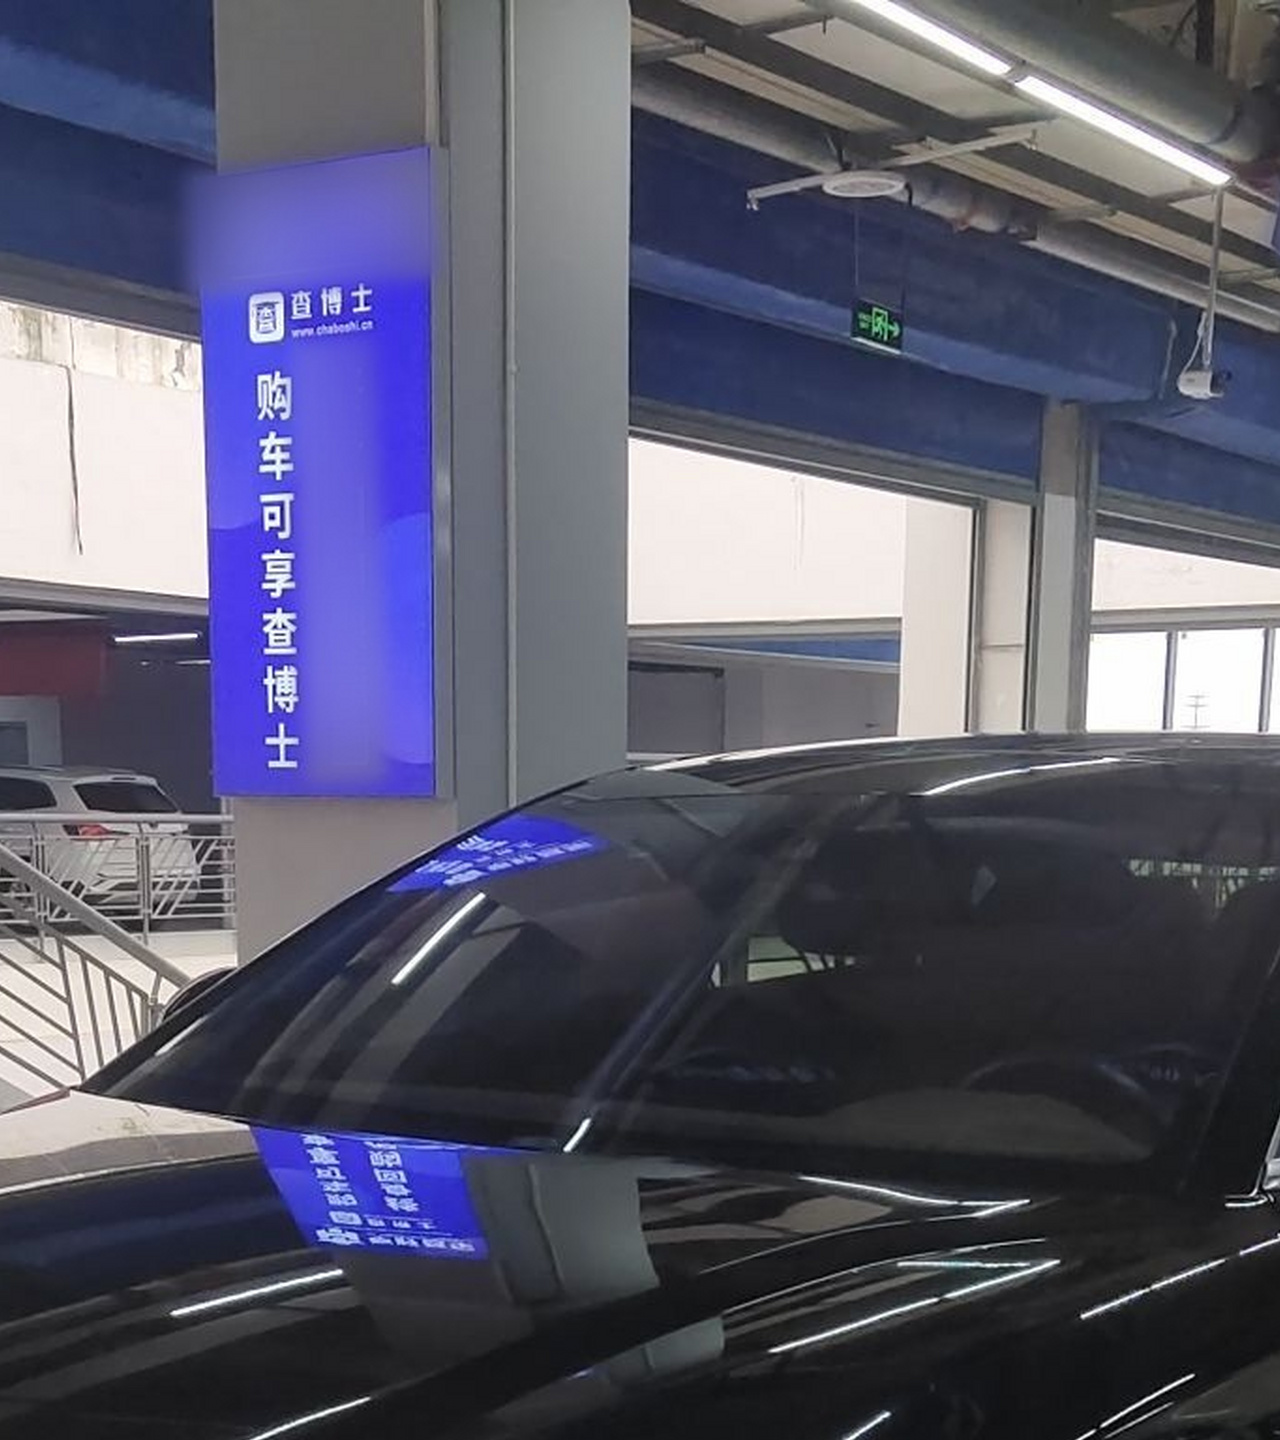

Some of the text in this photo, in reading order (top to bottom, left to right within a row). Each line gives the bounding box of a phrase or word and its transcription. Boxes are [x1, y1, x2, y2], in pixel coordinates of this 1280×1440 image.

[291, 283, 373, 320] 查博士
[255, 370, 299, 769] 购车可享查博士
